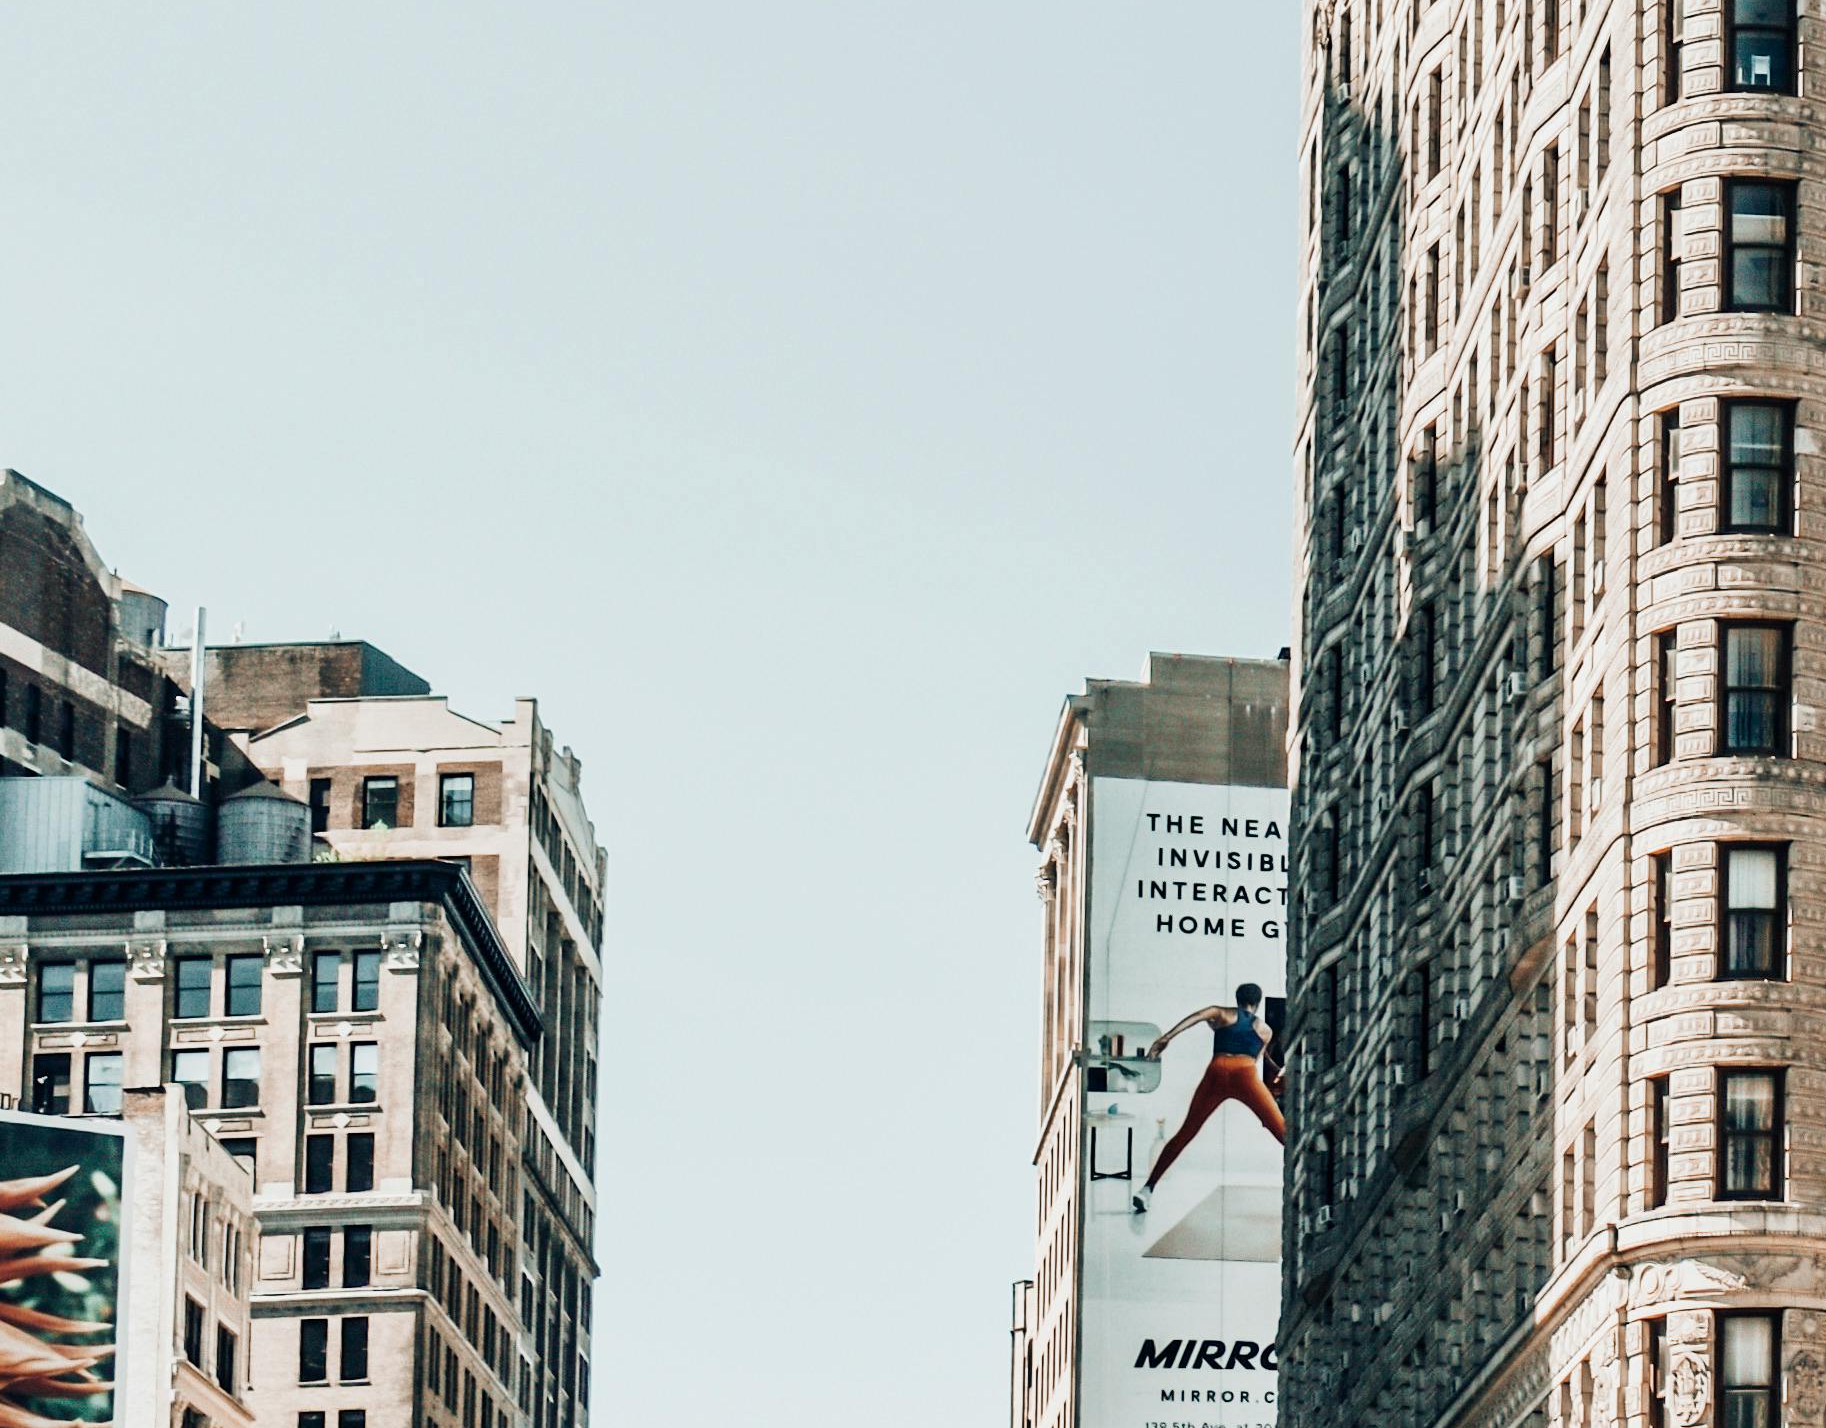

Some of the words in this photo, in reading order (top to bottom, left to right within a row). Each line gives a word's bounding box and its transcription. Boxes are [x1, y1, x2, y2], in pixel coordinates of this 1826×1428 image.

[1147, 814, 1204, 834] THE
[1222, 817, 1281, 839] NEA
[1158, 847, 1288, 873] INVISIBL
[1138, 880, 1288, 906] INTERACT
[1157, 914, 1245, 937] HOME
[1261, 920, 1288, 939] G
[1134, 1339, 1279, 1371] MIRRO
[1160, 1389, 1275, 1404] MIRROR.C
